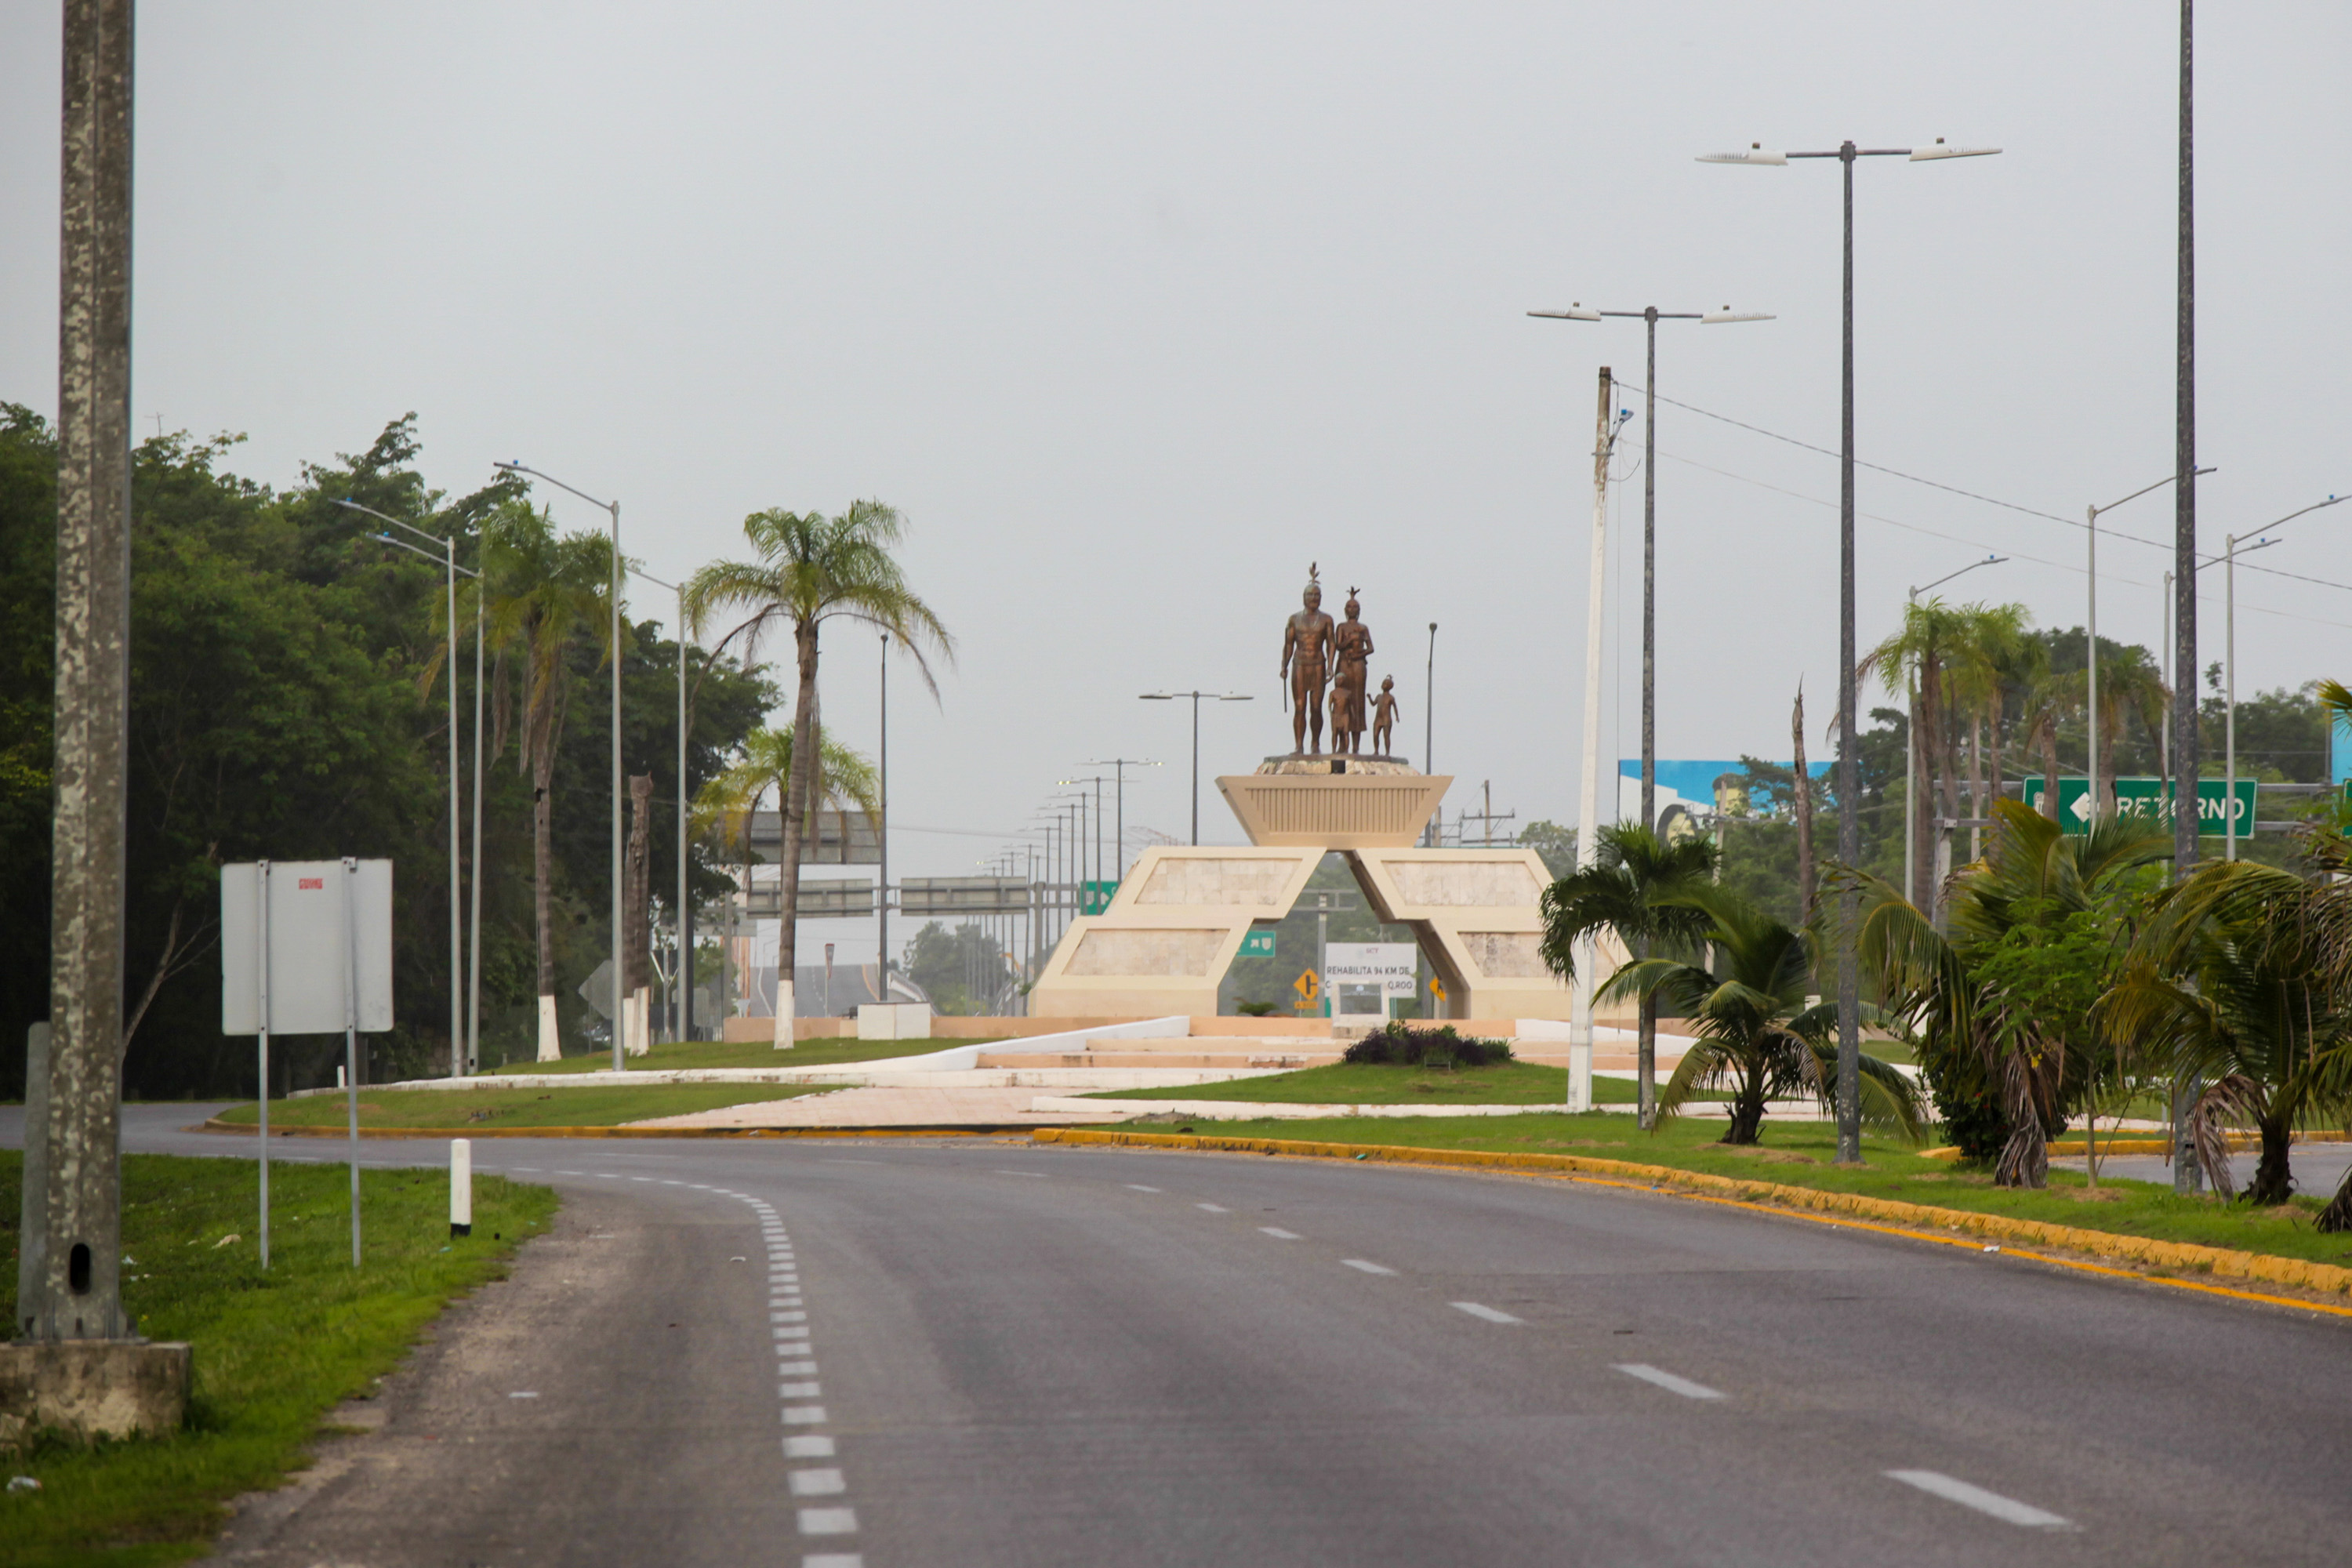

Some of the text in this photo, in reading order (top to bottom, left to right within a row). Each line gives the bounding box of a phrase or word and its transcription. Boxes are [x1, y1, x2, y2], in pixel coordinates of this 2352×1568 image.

[2117, 797, 2245, 820] RETRNO
[1327, 966, 1410, 975] REHABILITA 94 KM DE
